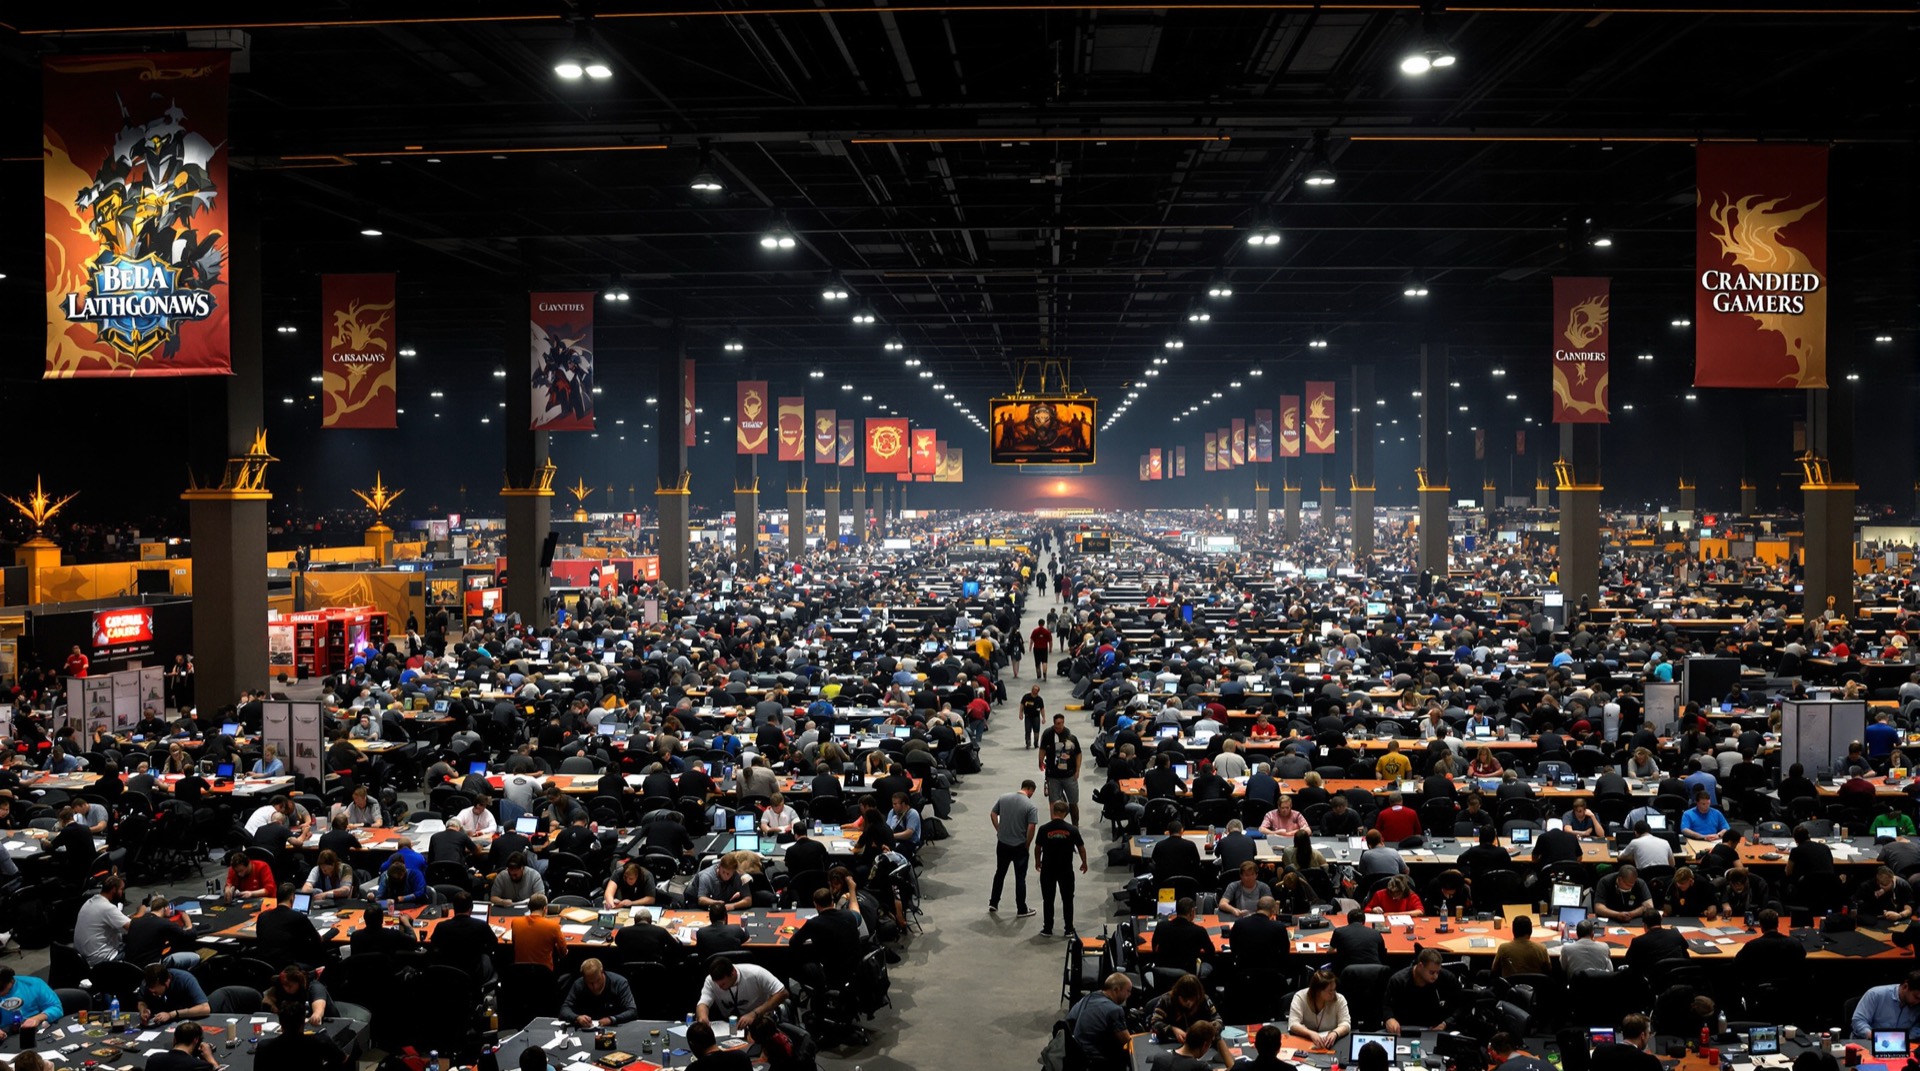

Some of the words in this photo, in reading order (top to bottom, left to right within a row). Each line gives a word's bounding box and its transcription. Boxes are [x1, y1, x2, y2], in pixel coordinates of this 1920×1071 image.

[1702, 270, 1819, 292] CRANDIED
[68, 293, 210, 319] LATHGONAWS
[1713, 292, 1804, 313] GAMERS
